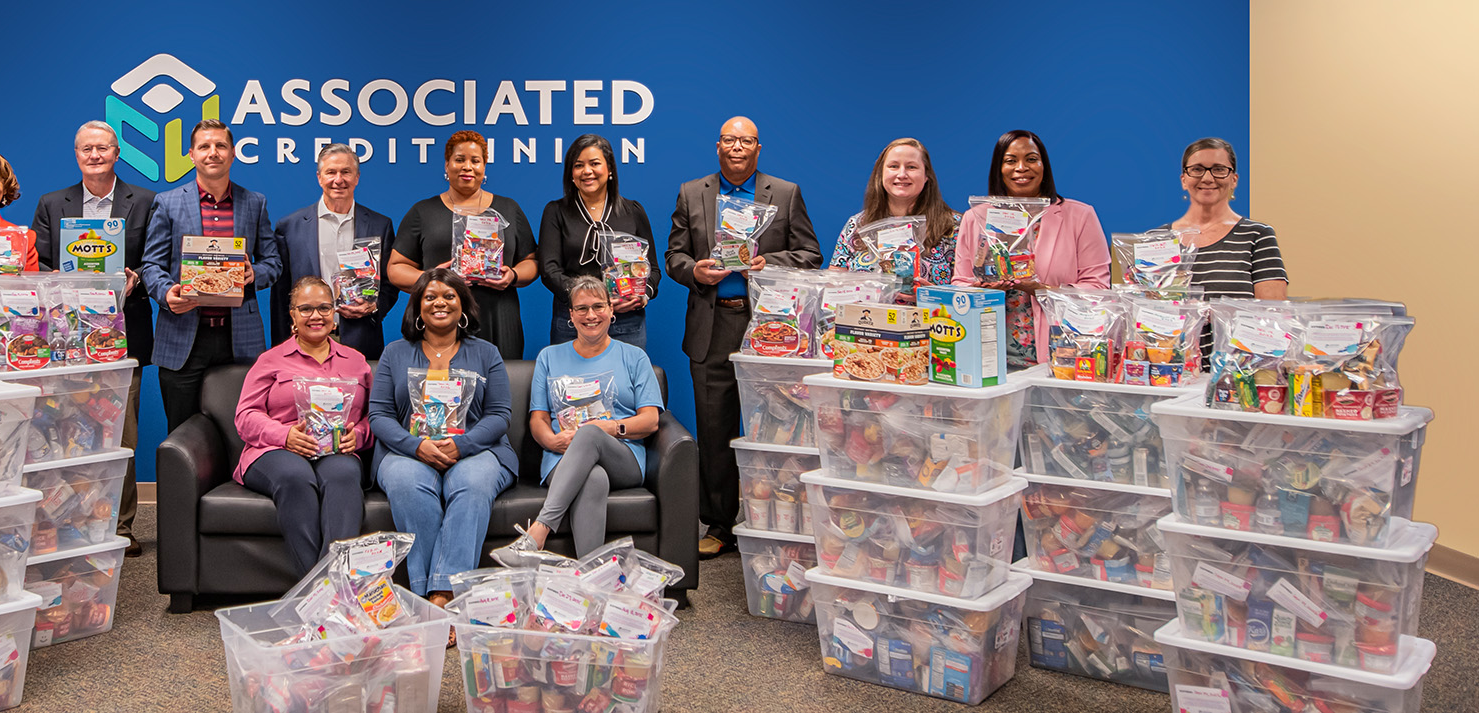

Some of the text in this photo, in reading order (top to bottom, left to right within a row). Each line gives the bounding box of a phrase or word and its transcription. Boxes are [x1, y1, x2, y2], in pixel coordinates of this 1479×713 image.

[231, 79, 655, 126] ASSOCIATED
[487, 137, 645, 164] NIN
[106, 220, 119, 228] 90
[956, 295, 967, 305] 90
